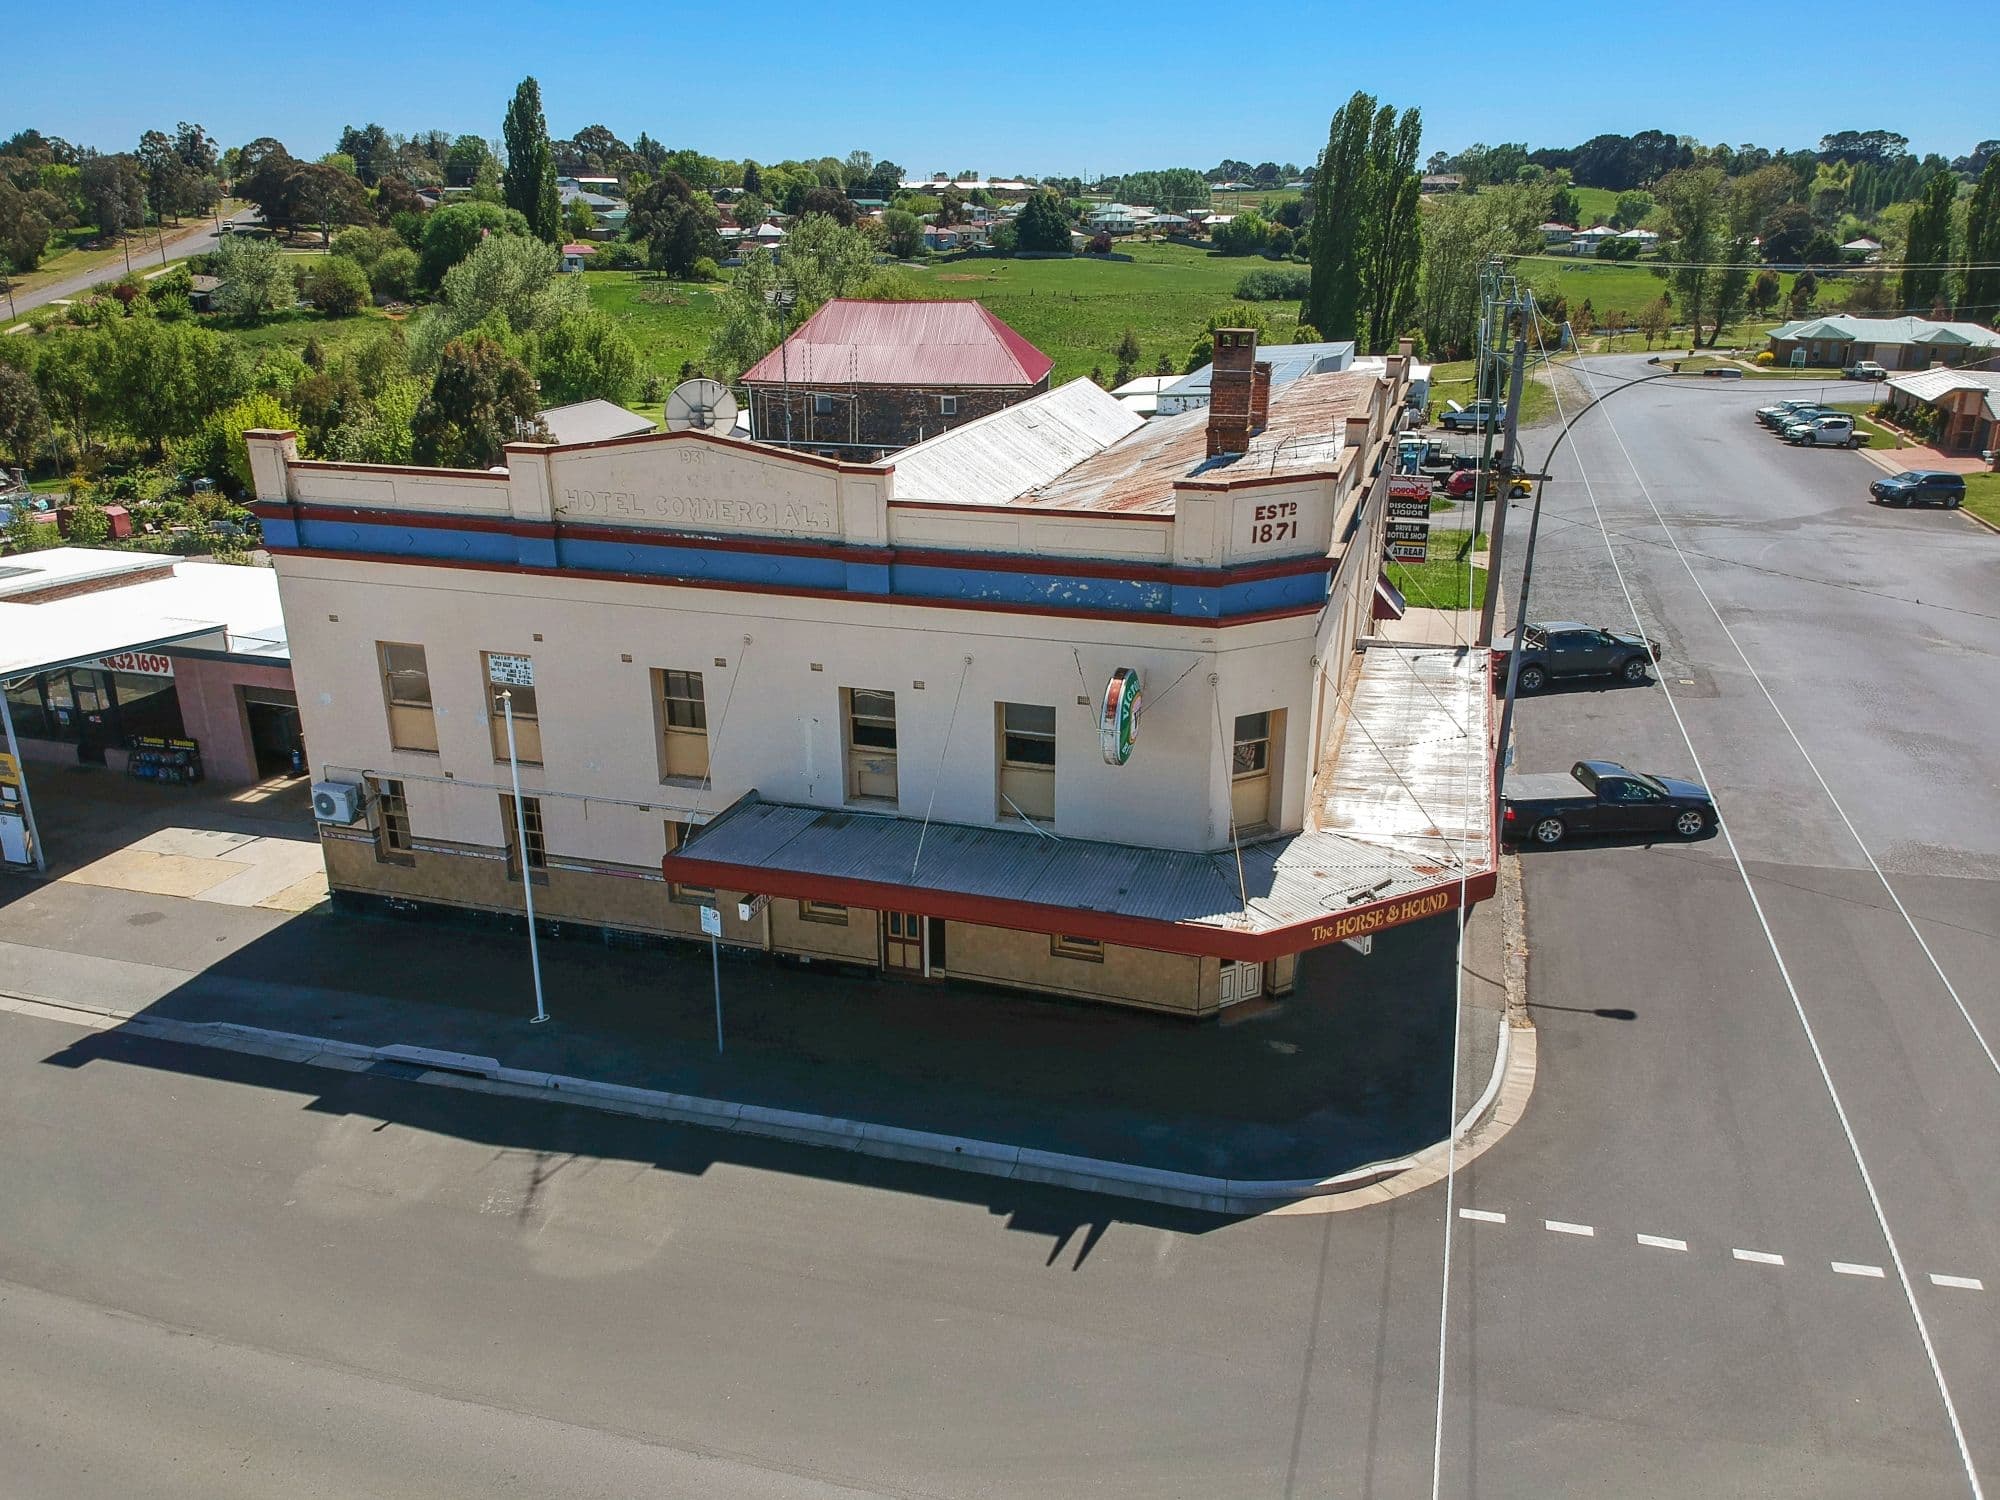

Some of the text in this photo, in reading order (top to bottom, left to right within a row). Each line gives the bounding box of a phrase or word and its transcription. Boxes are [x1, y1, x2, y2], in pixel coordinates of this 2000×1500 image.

[565, 489, 819, 528] HOTEL COMMERCIAL
[1389, 502, 1428, 510] DISCOUNT
[1252, 521, 1297, 544] 1871
[1410, 532, 1427, 540] SHOP
[1392, 547, 1423, 556] AT REAR
[1312, 926, 1333, 941] The
[1335, 909, 1385, 938] HORSE
[1386, 905, 1399, 922] &
[1400, 892, 1448, 919] HOUND
